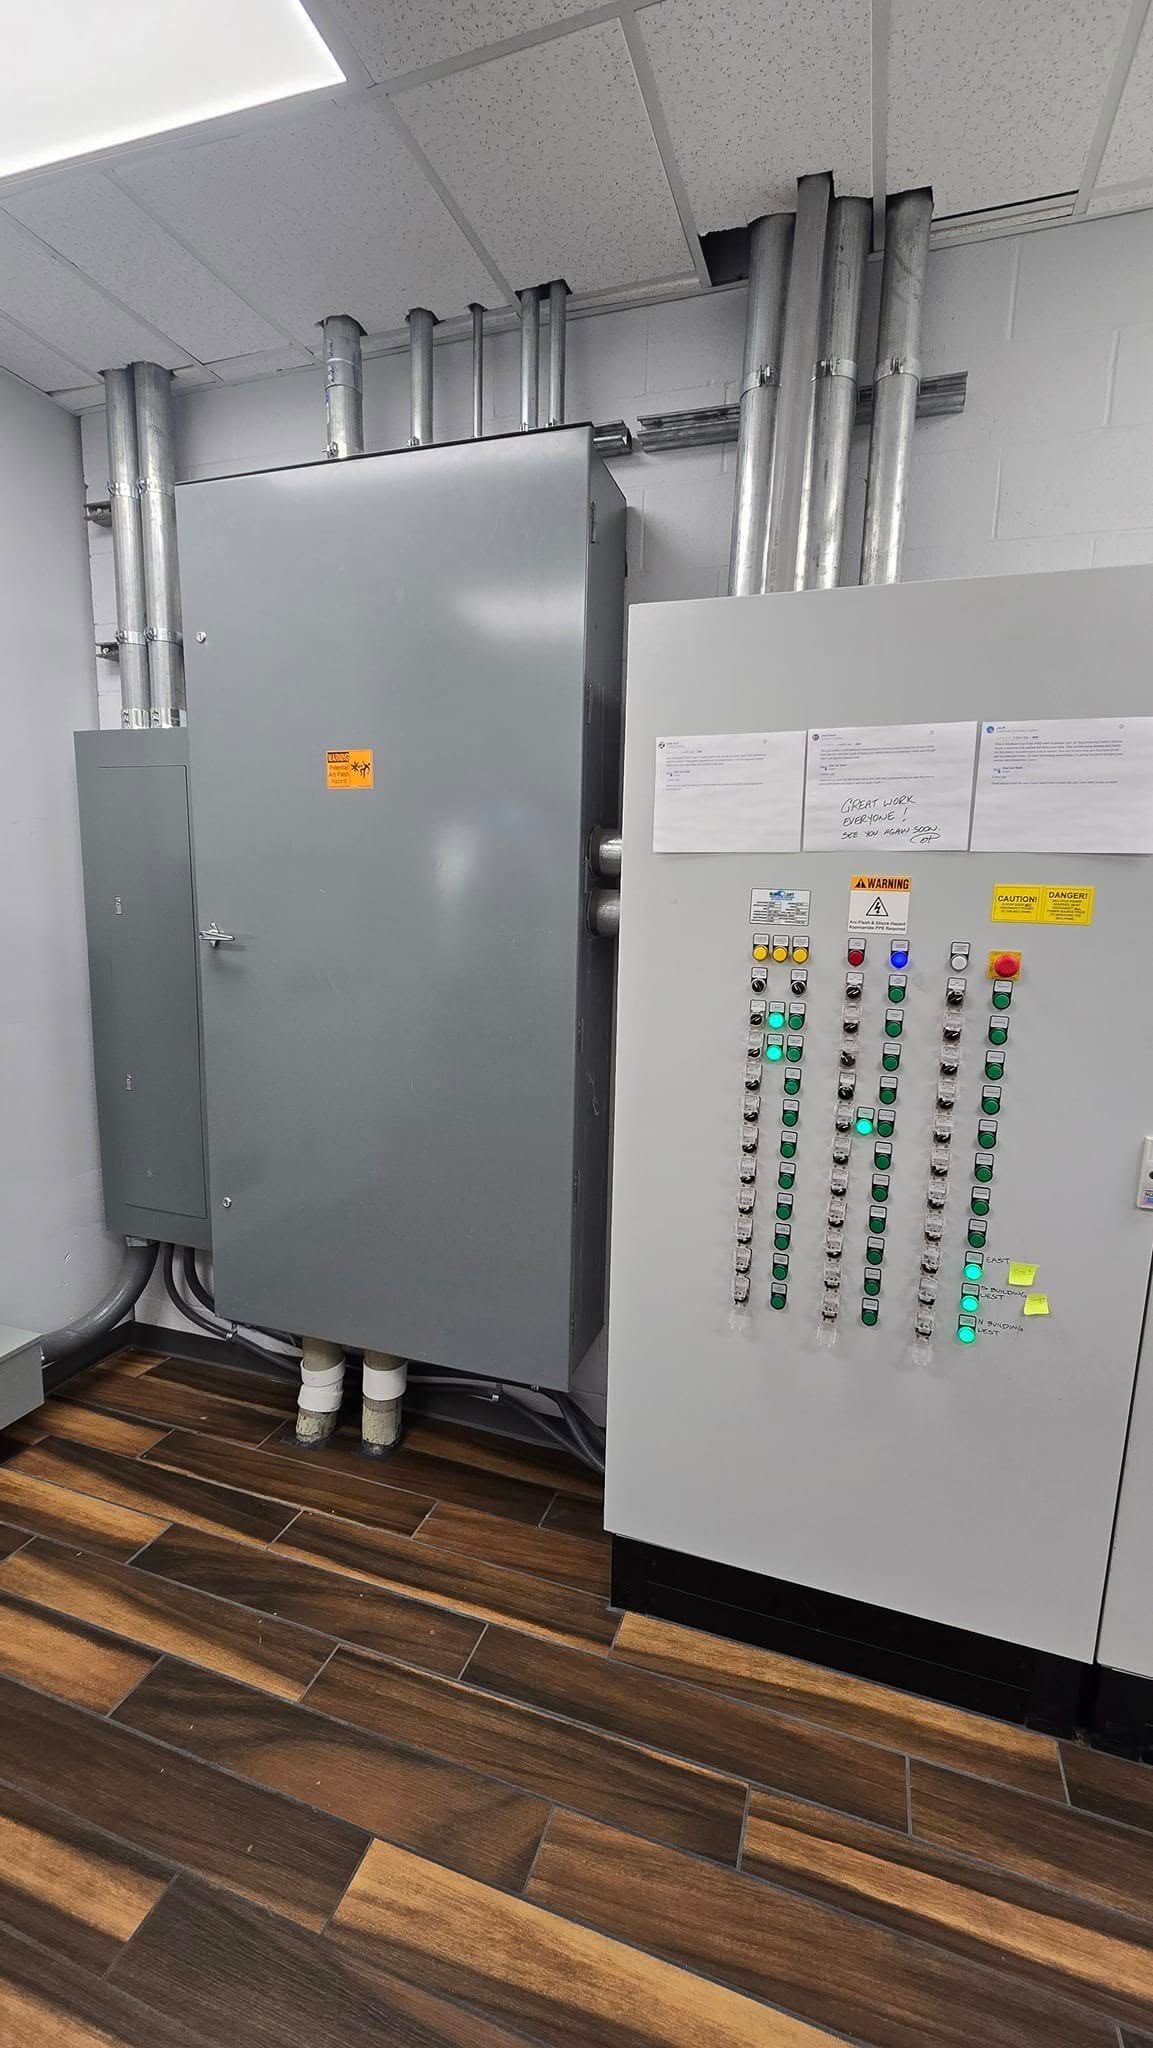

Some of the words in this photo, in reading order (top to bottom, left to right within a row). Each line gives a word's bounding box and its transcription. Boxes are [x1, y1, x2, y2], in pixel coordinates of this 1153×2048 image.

[841, 797, 879, 813] GREAT
[883, 795, 916, 807] WORK
[842, 811, 895, 827] EVERYONE
[841, 831, 859, 839] SEE
[864, 830, 879, 838] YOU
[883, 827, 910, 836] AGAIN
[867, 878, 910, 890] WARNING
[997, 895, 1038, 903] CAUTION!
[1048, 891, 1088, 900] DANGER!
[986, 1256, 1010, 1264] EAST
[990, 1287, 1027, 1298] BUILDING
[987, 1320, 1024, 1332] BUILDING
